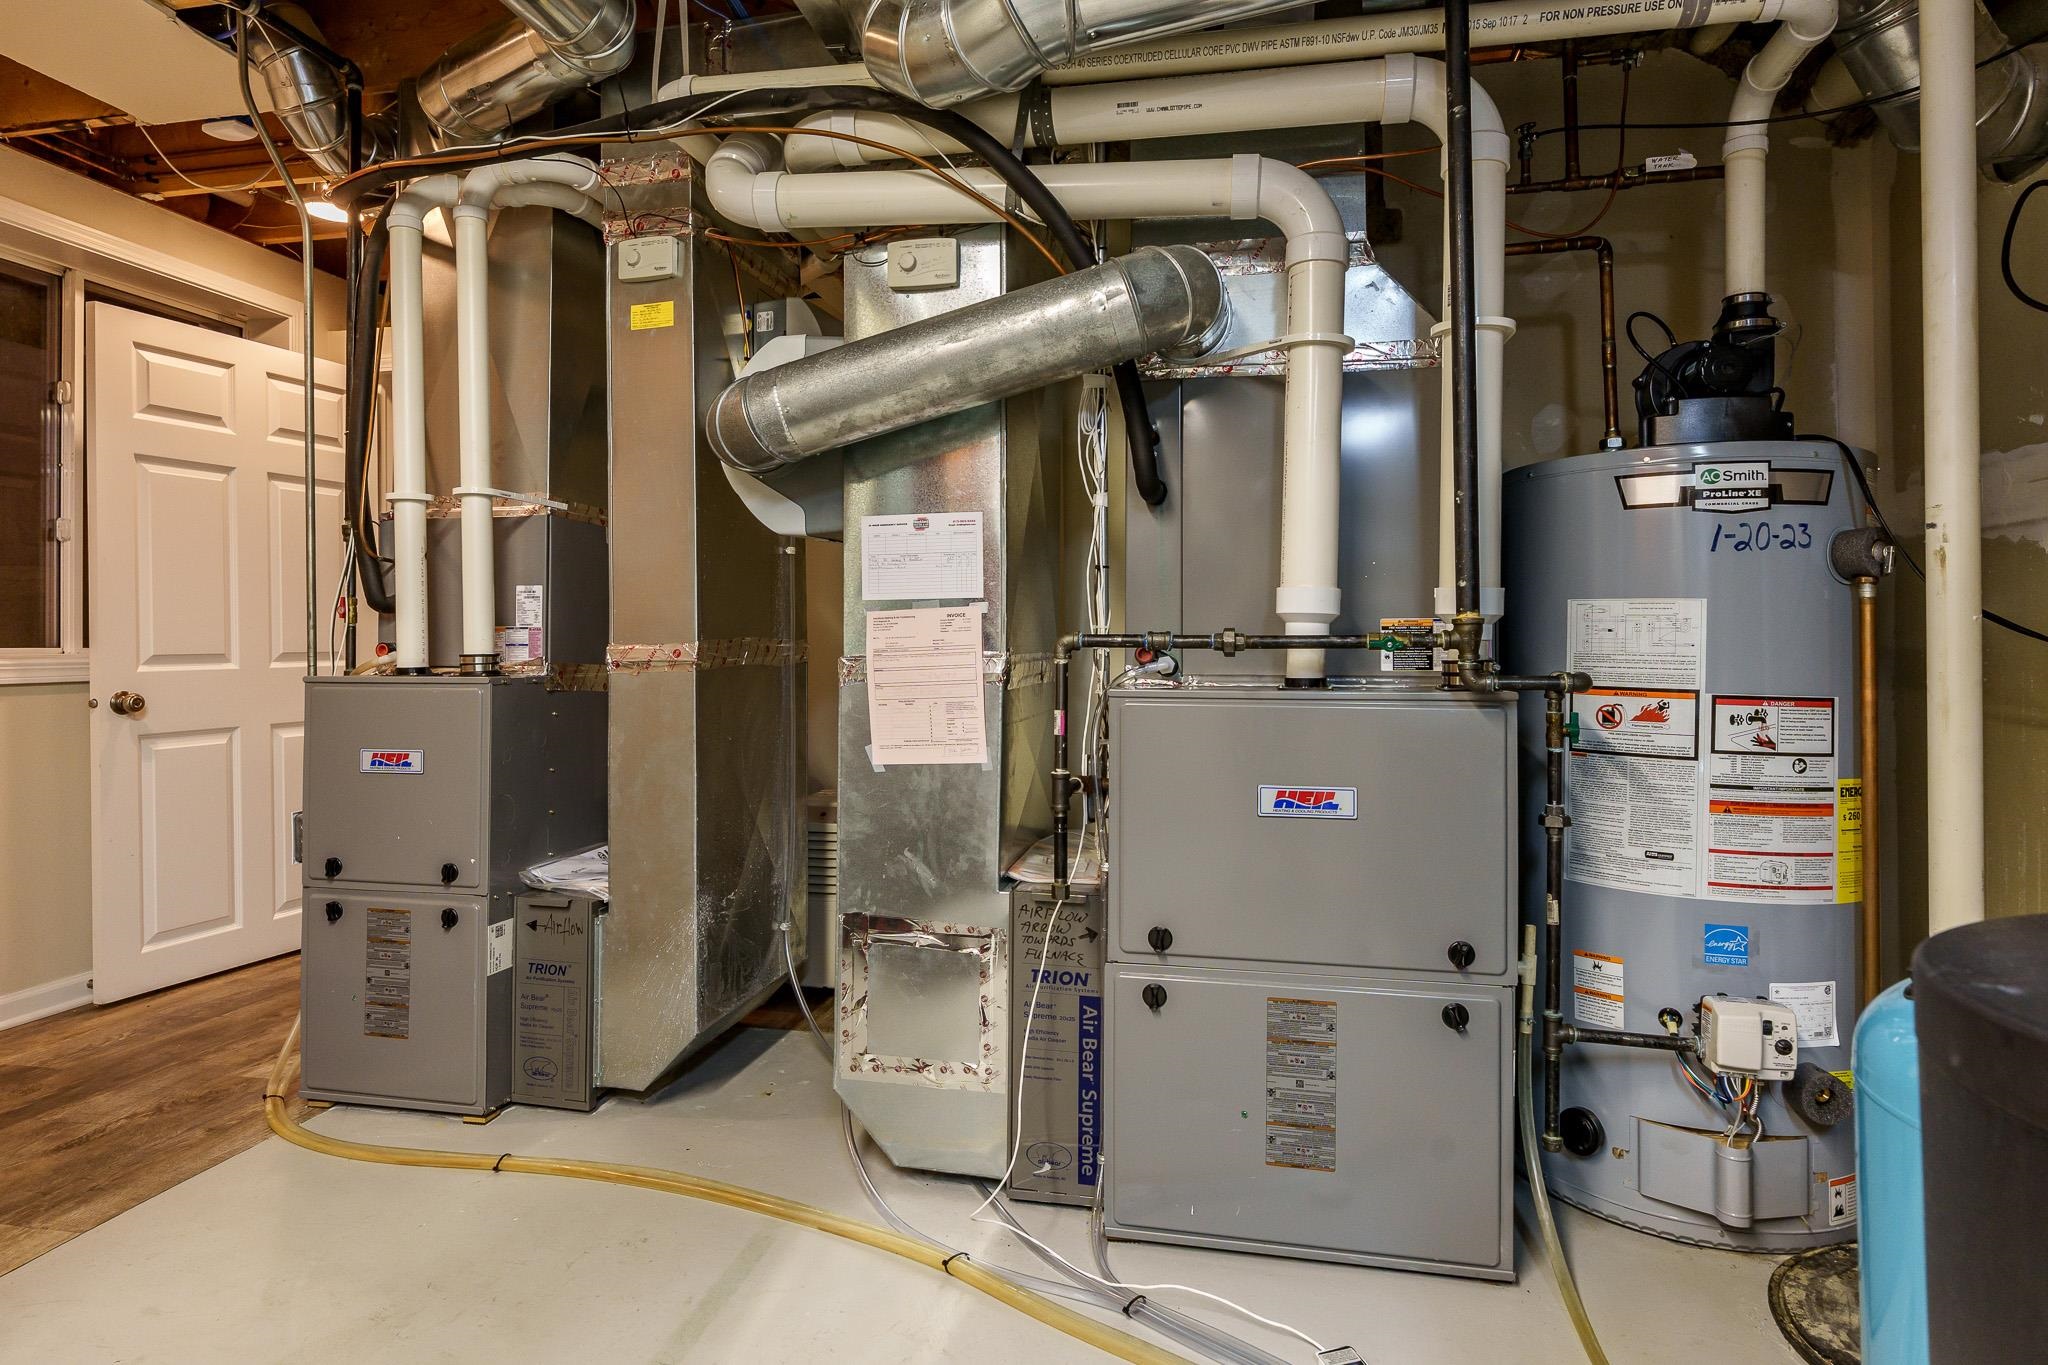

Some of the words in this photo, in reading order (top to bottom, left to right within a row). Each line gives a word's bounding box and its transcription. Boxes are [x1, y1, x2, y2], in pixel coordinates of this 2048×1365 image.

[1086, 56, 1112, 68] SERIES
[1114, 50, 1164, 64] COEXTRUDED
[1164, 47, 1201, 60] CELLULAR
[1202, 44, 1224, 57] CORE
[1224, 42, 1240, 54] PVC
[1242, 40, 1260, 52] DWV
[1260, 38, 1278, 50] PIPE
[1279, 35, 1300, 50] ASTM
[1302, 34, 1330, 47] F891-10
[1331, 31, 1360, 45] NSFdwv
[1378, 28, 1396, 39] Code
[1398, 23, 1438, 38] JM30/JM35
[1482, 18, 1497, 30] Sep
[1540, 10, 1560, 22] FOR
[1562, 8, 1584, 20] NON
[1586, 2, 1642, 18] PRESSURE
[1644, 0, 1665, 12] USE
[1668, 0, 1683, 10] ON
[1710, 522, 1812, 552] 1-20-23
[1018, 904, 1088, 922] AIRFLOW
[1020, 920, 1072, 934] ARROW
[1022, 935, 1076, 946] TOWARDS
[528, 962, 568, 976] TRION
[1705, 956, 1730, 964] ENERGY
[1730, 957, 1747, 965] STAR
[1031, 968, 1089, 986] TRION
[1024, 1010, 1058, 1021] Spreme
[1083, 1006, 1098, 1033] Air
[1083, 1038, 1098, 1082] Bear
[1079, 1090, 1098, 1176] Supreme
